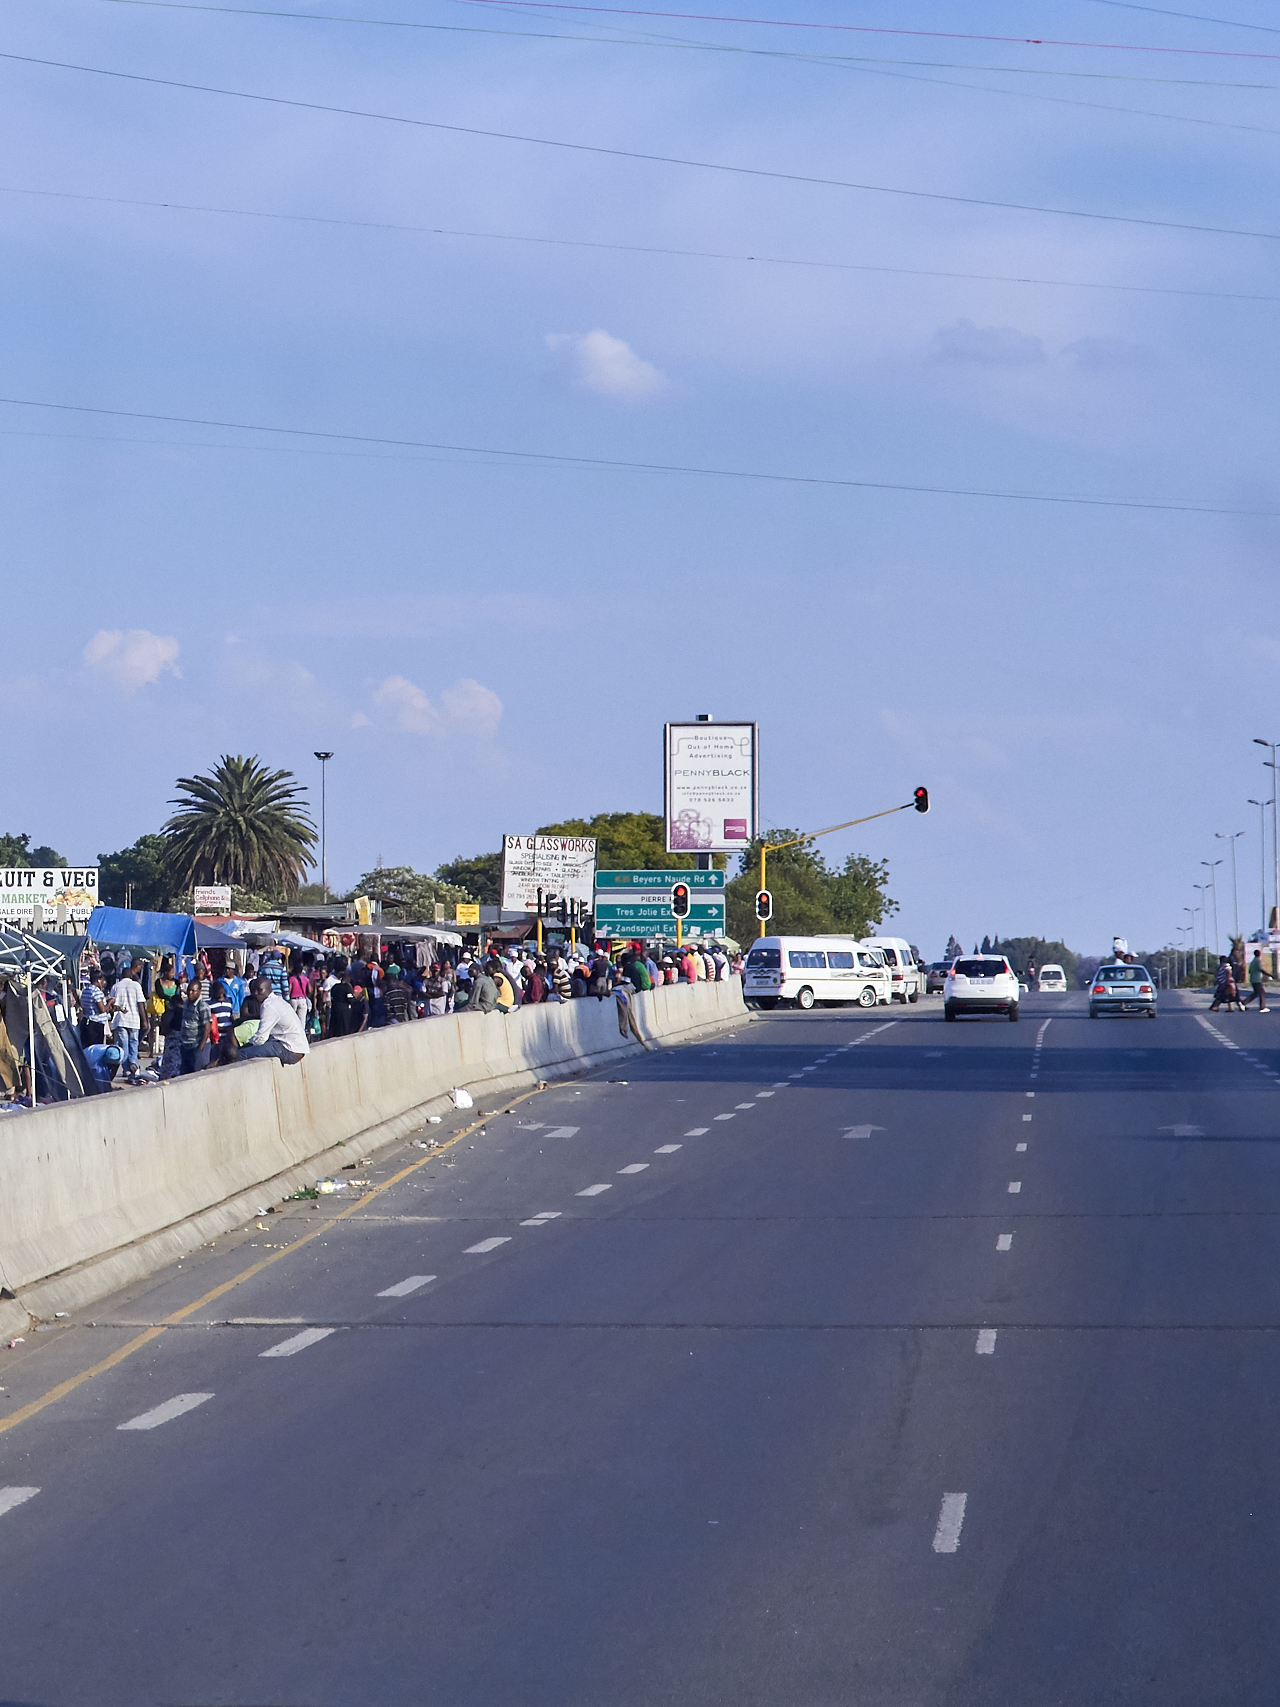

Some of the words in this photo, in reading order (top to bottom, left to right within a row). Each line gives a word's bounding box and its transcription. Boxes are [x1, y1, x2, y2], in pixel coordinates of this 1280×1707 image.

[507, 836, 522, 850] SA
[526, 837, 595, 853] GLASSWORKS
[43, 871, 54, 888] &
[61, 871, 96, 888] VEG
[633, 875, 661, 883] Beyers
[665, 875, 691, 883] Naude
[694, 875, 705, 883] Rd
[1, 893, 47, 904] MARKET
[616, 924, 660, 934] Zandspruit
